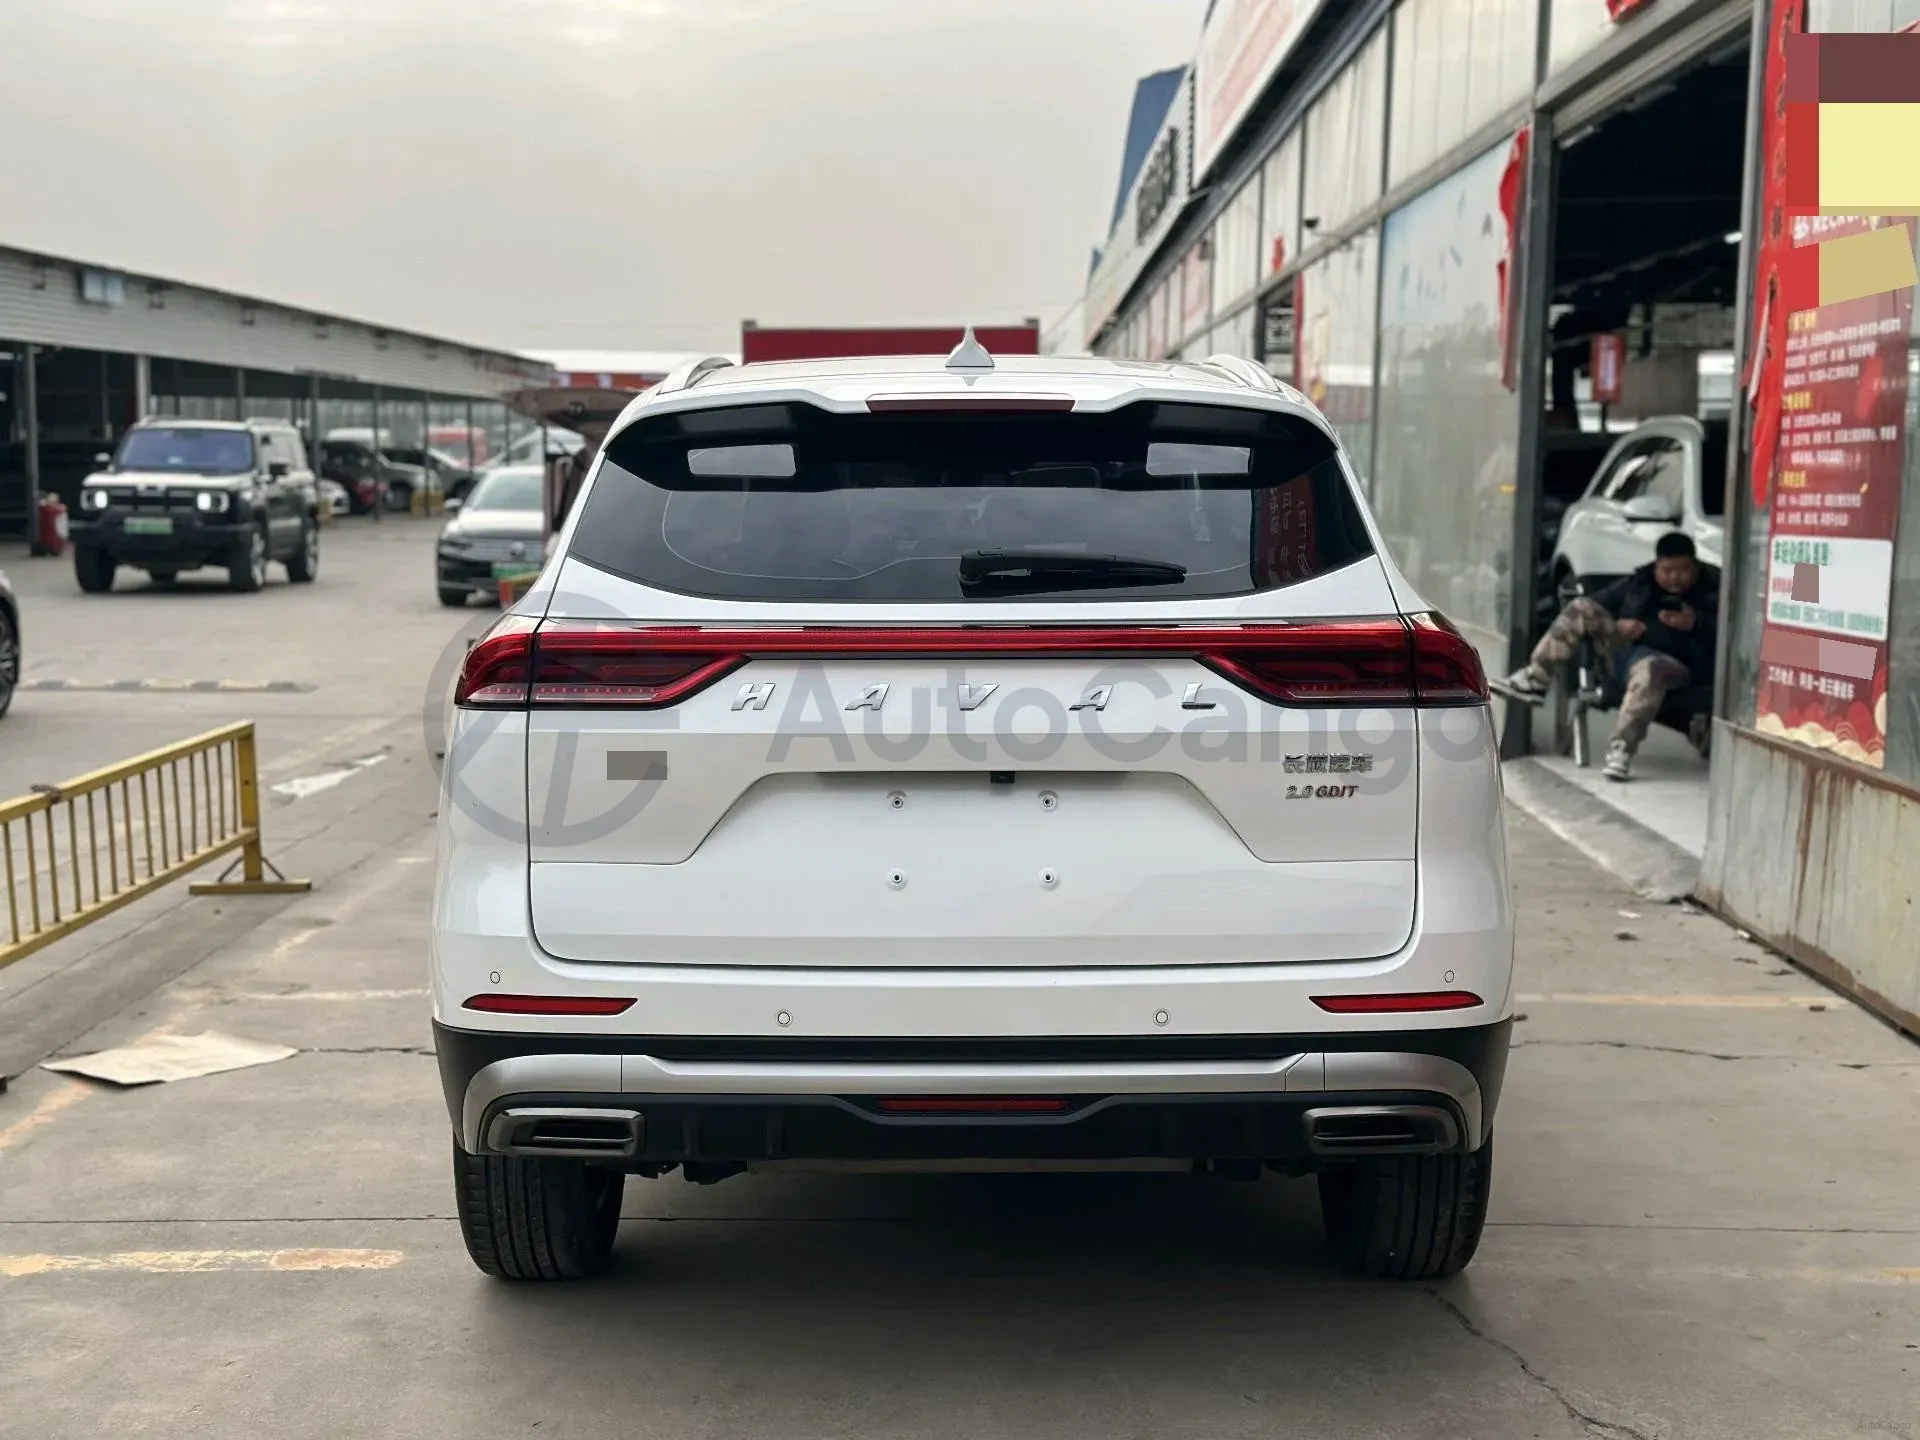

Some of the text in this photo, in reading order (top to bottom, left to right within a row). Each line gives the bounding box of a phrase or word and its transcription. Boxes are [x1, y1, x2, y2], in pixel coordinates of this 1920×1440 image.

[731, 683, 1217, 711] HAVAL
[1282, 753, 1373, 773] 长城汽车
